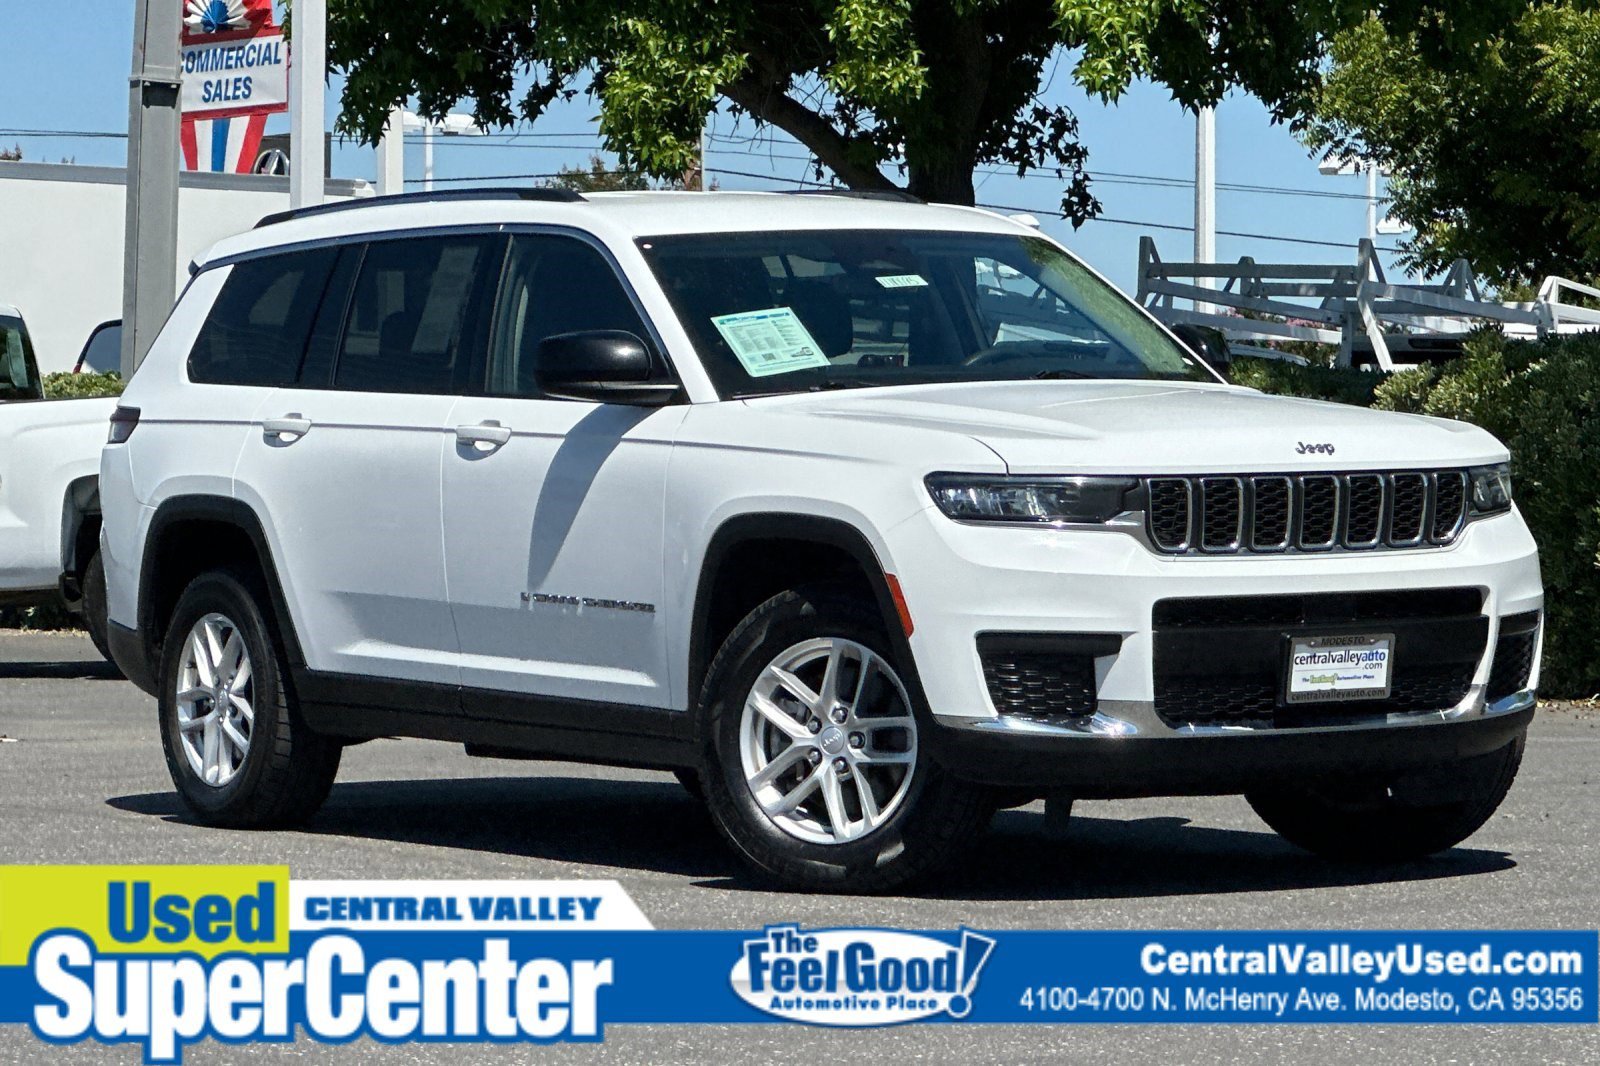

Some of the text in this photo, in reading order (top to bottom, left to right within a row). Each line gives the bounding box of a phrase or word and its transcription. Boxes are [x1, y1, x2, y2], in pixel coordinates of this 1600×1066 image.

[202, 76, 253, 103] SALES
[1295, 441, 1335, 456] Jeep
[1321, 636, 1365, 645] MODESTO
[1294, 650, 1386, 666] centralvalleyauto
[1292, 688, 1386, 701] centralvalleyauto.com
